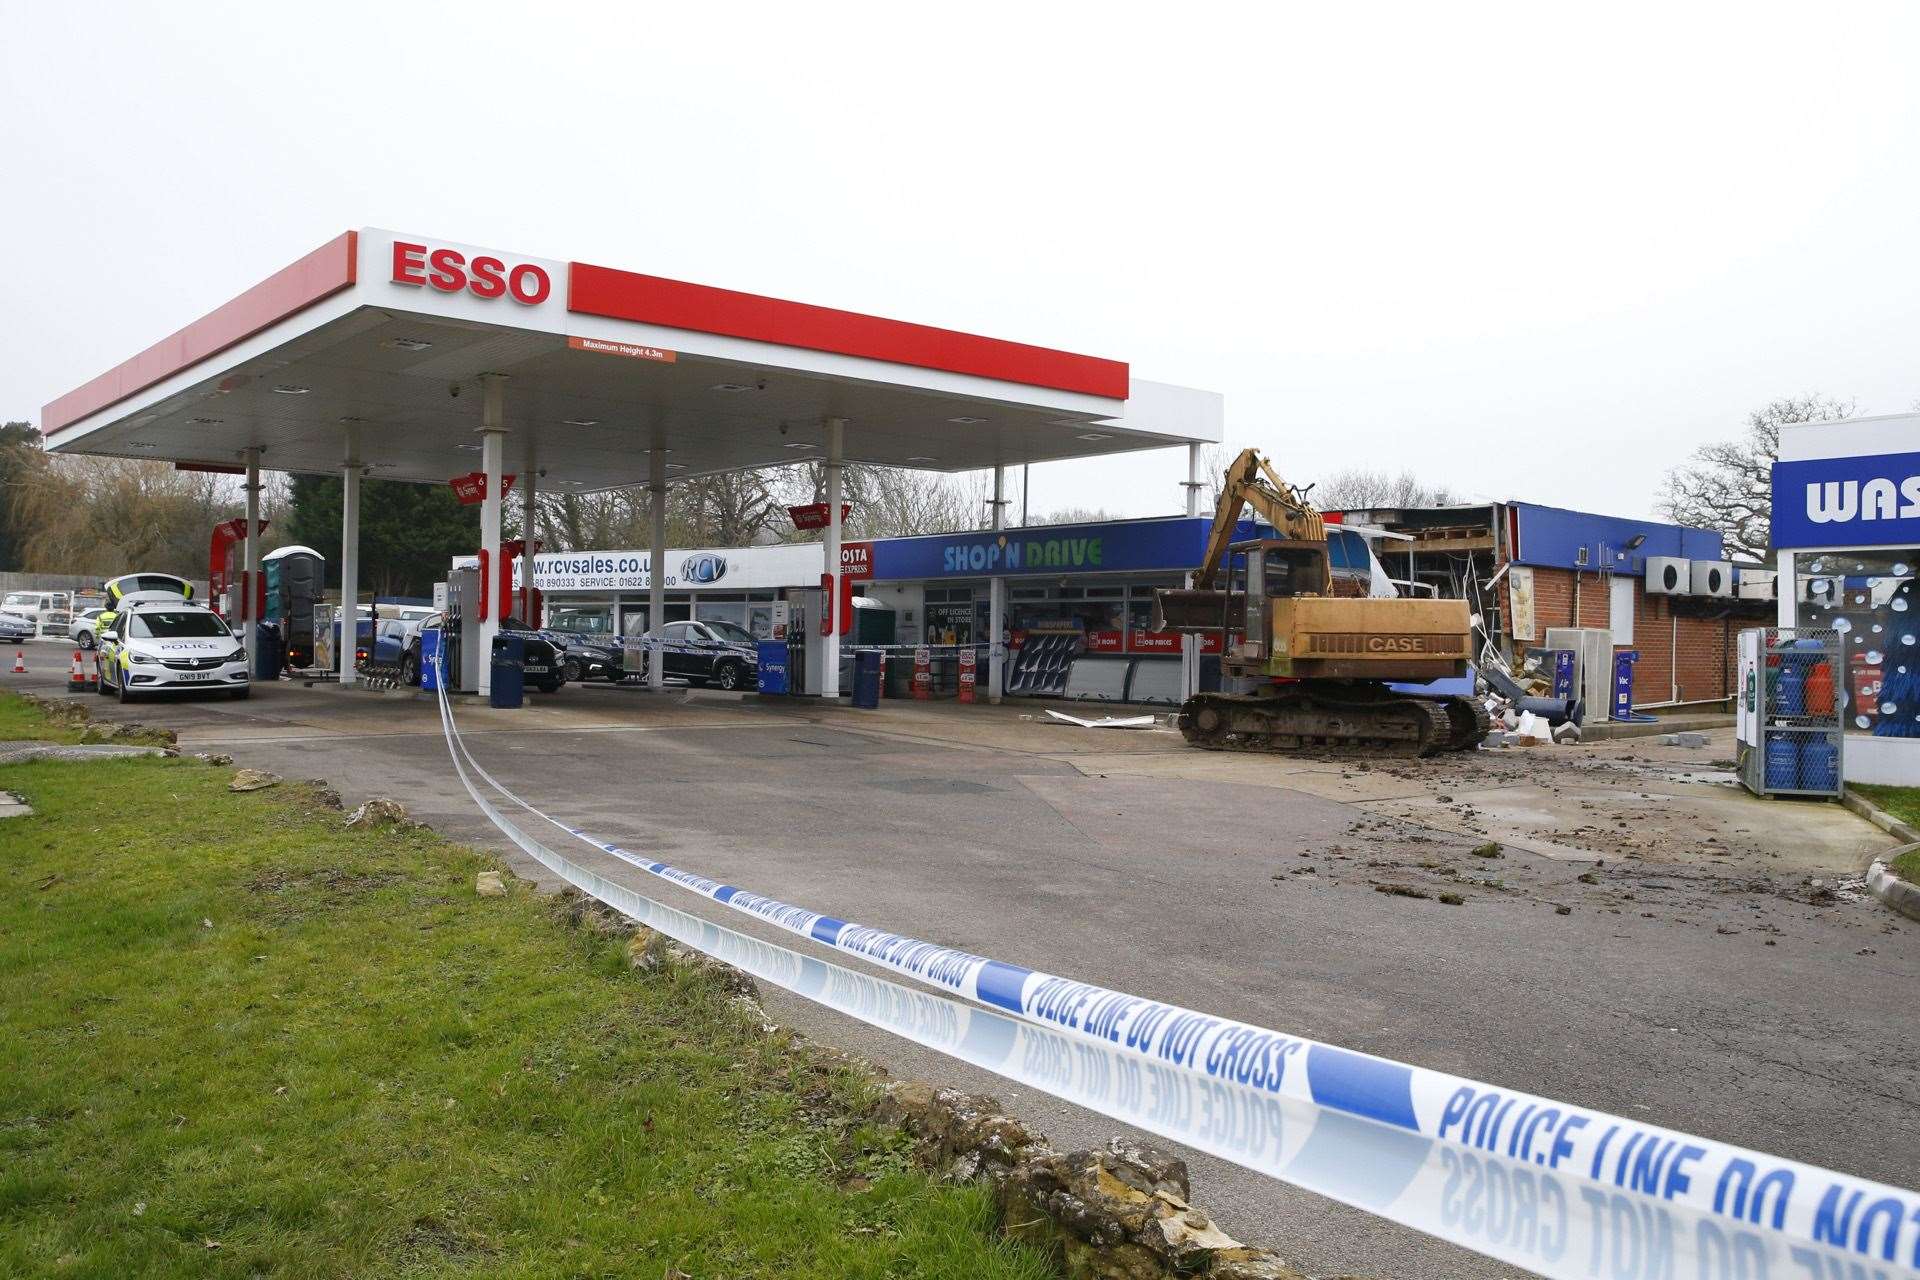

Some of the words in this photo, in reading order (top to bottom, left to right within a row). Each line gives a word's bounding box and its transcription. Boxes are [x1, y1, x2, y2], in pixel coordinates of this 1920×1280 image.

[392, 240, 551, 305] ESSO
[582, 339, 619, 352] Maximum
[619, 344, 644, 356] Height
[644, 349, 664, 358] 4.3m
[478, 477, 485, 486] 6
[501, 479, 508, 488] 5
[823, 506, 830, 515] 2
[841, 548, 867, 564] OSTA
[1025, 538, 1103, 568] DRIVE
[683, 554, 726, 582] RCV
[844, 564, 868, 575] EXPRESS
[546, 577, 576, 588] 890333
[580, 576, 617, 588] SERVICE:
[619, 576, 642, 587] 01622
[1369, 637, 1424, 652] CASE
[179, 673, 196, 681] GN19
[197, 672, 211, 680] BVT
[766, 663, 785, 675] Synergy
[1026, 977, 1101, 1029] POLICE
[1083, 992, 1137, 1043] LINE
[1126, 1000, 1174, 1054] DO
[1158, 1012, 1221, 1069] NOT
[1205, 1024, 1303, 1094] CROSS
[1438, 1086, 1590, 1169] POLICE
[1591, 1126, 1707, 1201] LINE
[1712, 1157, 1795, 1230] DO
